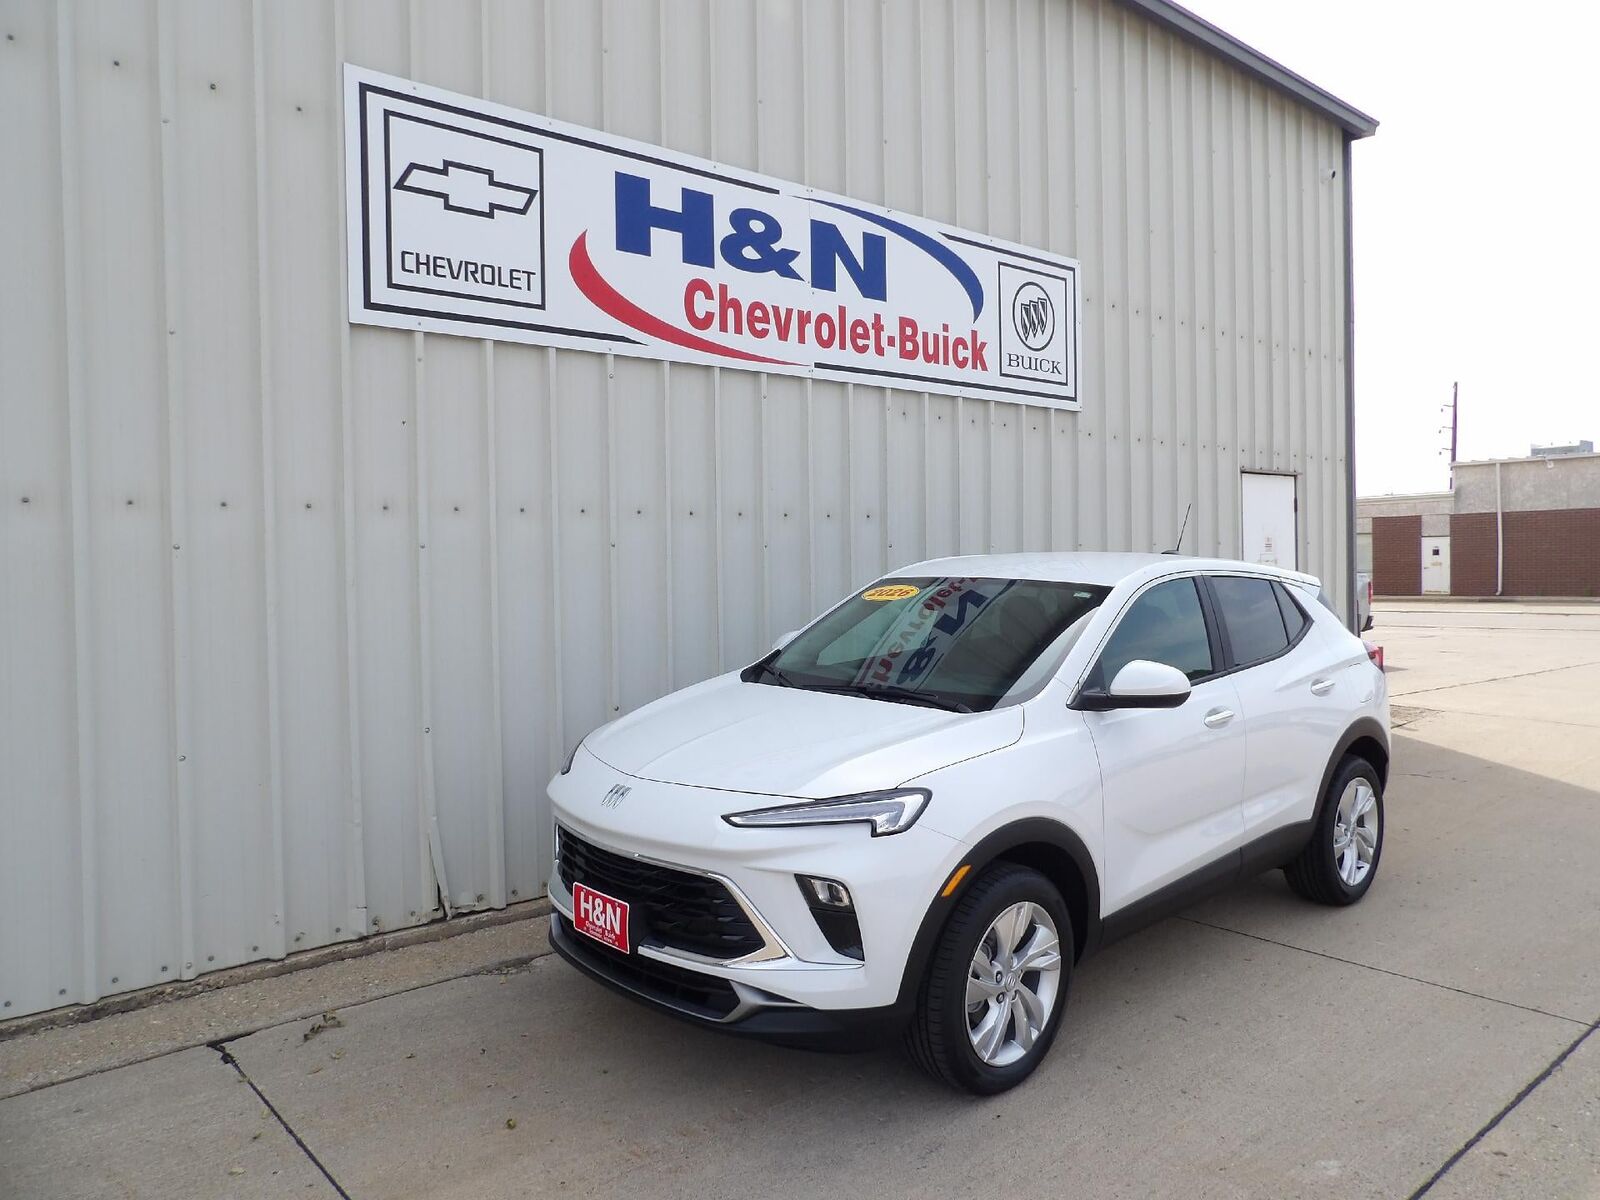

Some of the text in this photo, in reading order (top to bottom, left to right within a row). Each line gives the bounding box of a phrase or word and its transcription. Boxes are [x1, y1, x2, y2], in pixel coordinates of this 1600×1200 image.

[615, 171, 887, 302] H&N
[401, 250, 536, 292] CHEVROLET
[684, 278, 989, 372] Chevrolet-Buick
[1007, 353, 1062, 375] BUICK
[580, 891, 621, 935] H&N
